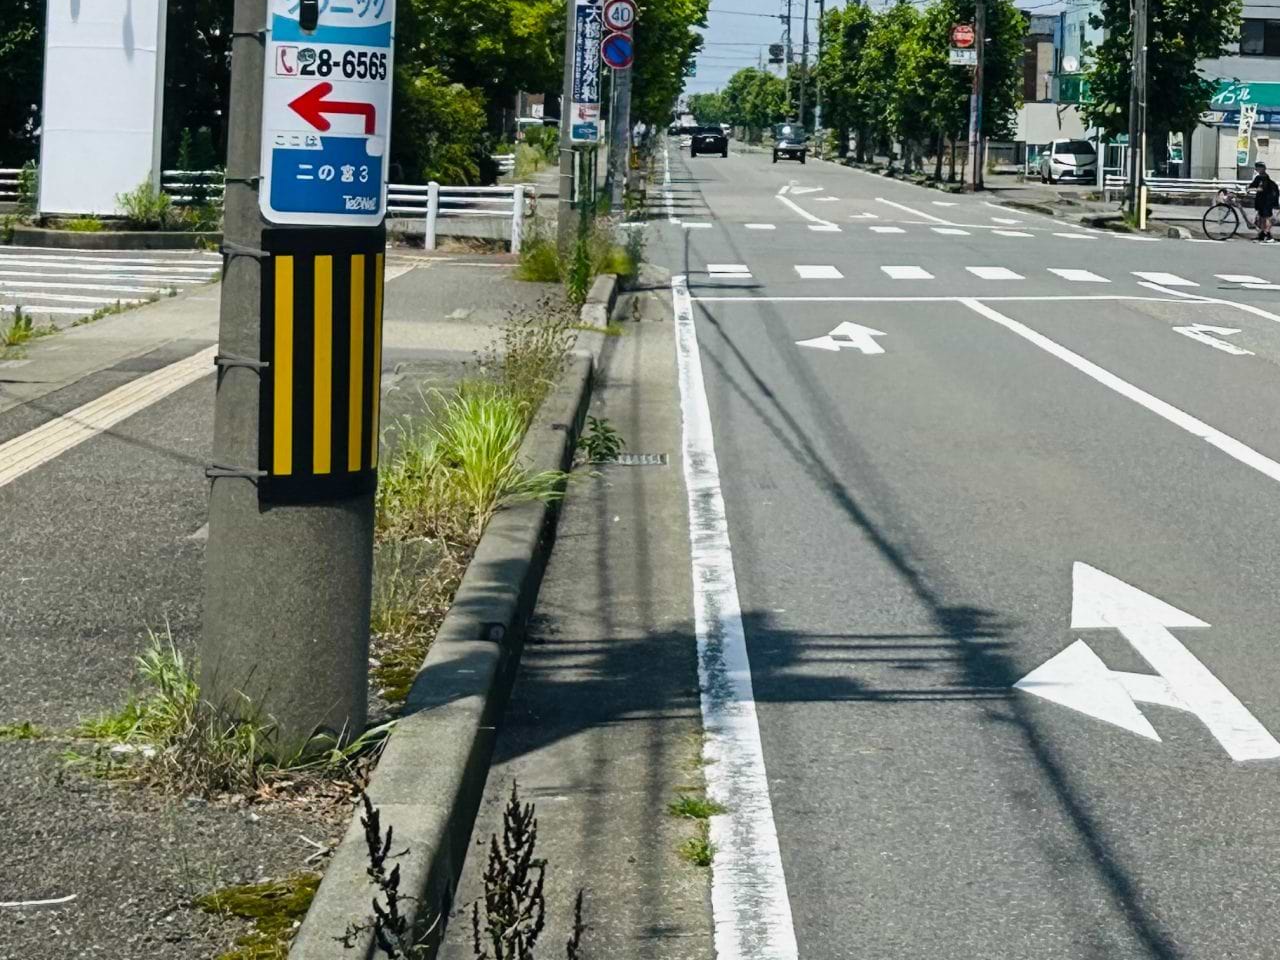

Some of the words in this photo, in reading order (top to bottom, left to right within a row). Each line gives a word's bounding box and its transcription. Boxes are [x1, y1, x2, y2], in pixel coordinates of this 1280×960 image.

[611, 7, 631, 23] 40
[299, 48, 387, 81] 28-6565
[274, 135, 318, 147] ここは
